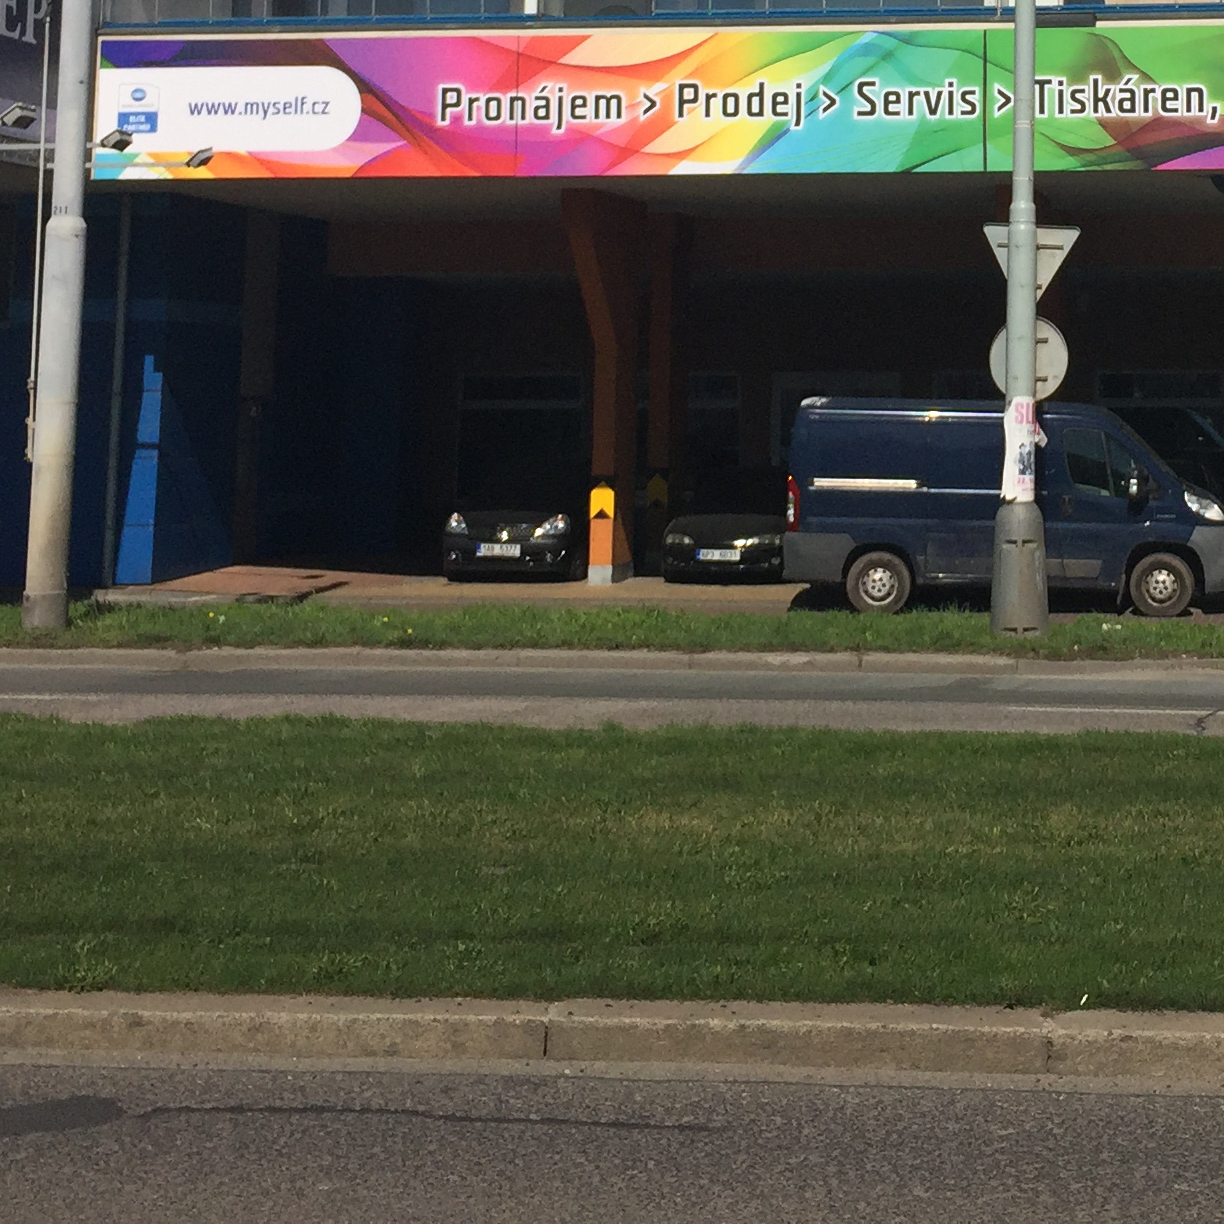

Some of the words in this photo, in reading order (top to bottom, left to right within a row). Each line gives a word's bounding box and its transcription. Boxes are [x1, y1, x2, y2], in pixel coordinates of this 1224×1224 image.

[188, 96, 331, 121] www.myself.cz
[440, 86, 622, 130] Pronájem
[678, 82, 803, 127] Prodej
[856, 79, 977, 116] Servis
[1033, 76, 1218, 121] Tiskáren,
